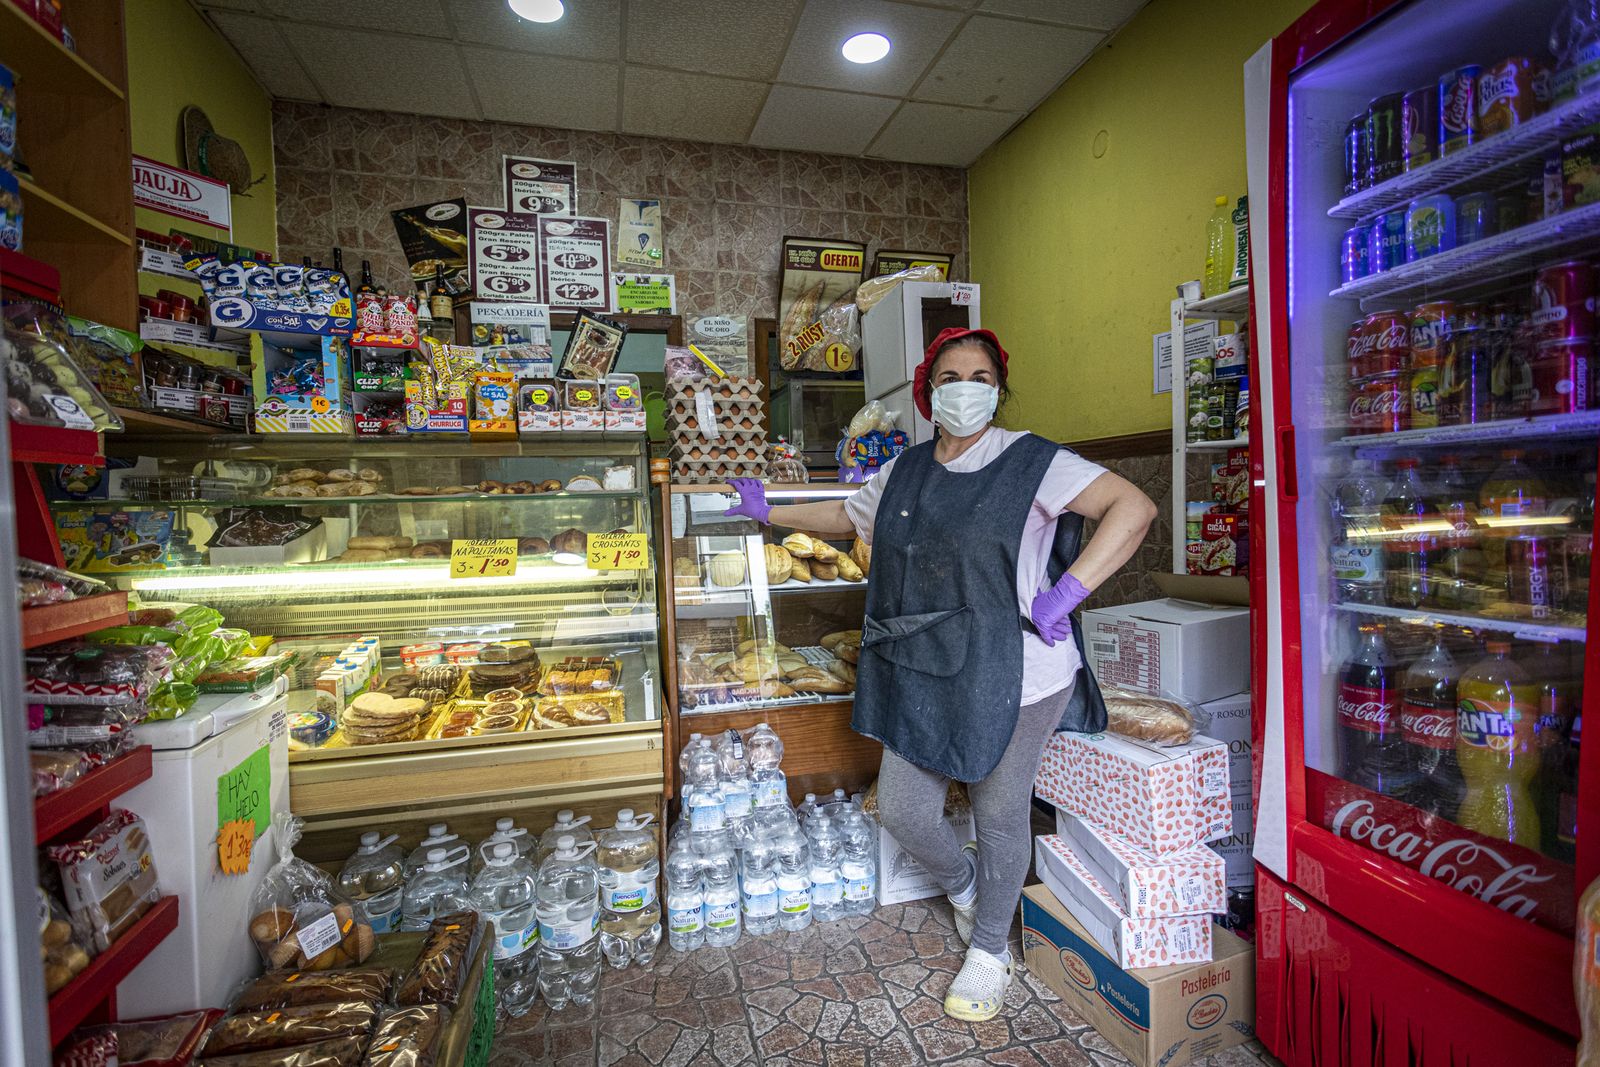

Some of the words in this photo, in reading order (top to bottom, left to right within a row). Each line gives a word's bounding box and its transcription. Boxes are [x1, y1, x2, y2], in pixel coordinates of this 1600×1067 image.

[133, 167, 192, 200] JAUJA
[1235, 226, 1249, 276] MAYONESA
[823, 253, 860, 268] OFERTA
[477, 307, 545, 318] PESCADERÍA
[266, 316, 283, 325] CON
[283, 315, 302, 327] SAL
[787, 341, 801, 357] 2
[490, 391, 507, 399] SAL
[452, 401, 463, 409] 10
[429, 420, 462, 428] CHURRUCA
[1207, 523, 1232, 533] CIGALA
[592, 540, 642, 549] CROISANTS
[453, 546, 517, 557] NAPOLITANAS
[591, 552, 600, 563] 3
[613, 550, 641, 567] 1'50
[456, 561, 467, 573] 3
[478, 557, 510, 575] 1'50
[1529, 565, 1546, 618] ENERGY
[228, 762, 253, 803] HAY
[1332, 799, 1556, 923] Coca-Cola
[785, 896, 808, 905] Natura
[671, 915, 697, 924] Natura
[709, 911, 735, 919] Natura
[1182, 966, 1231, 997] Pastelería
[1105, 981, 1141, 1018] Pastelería
